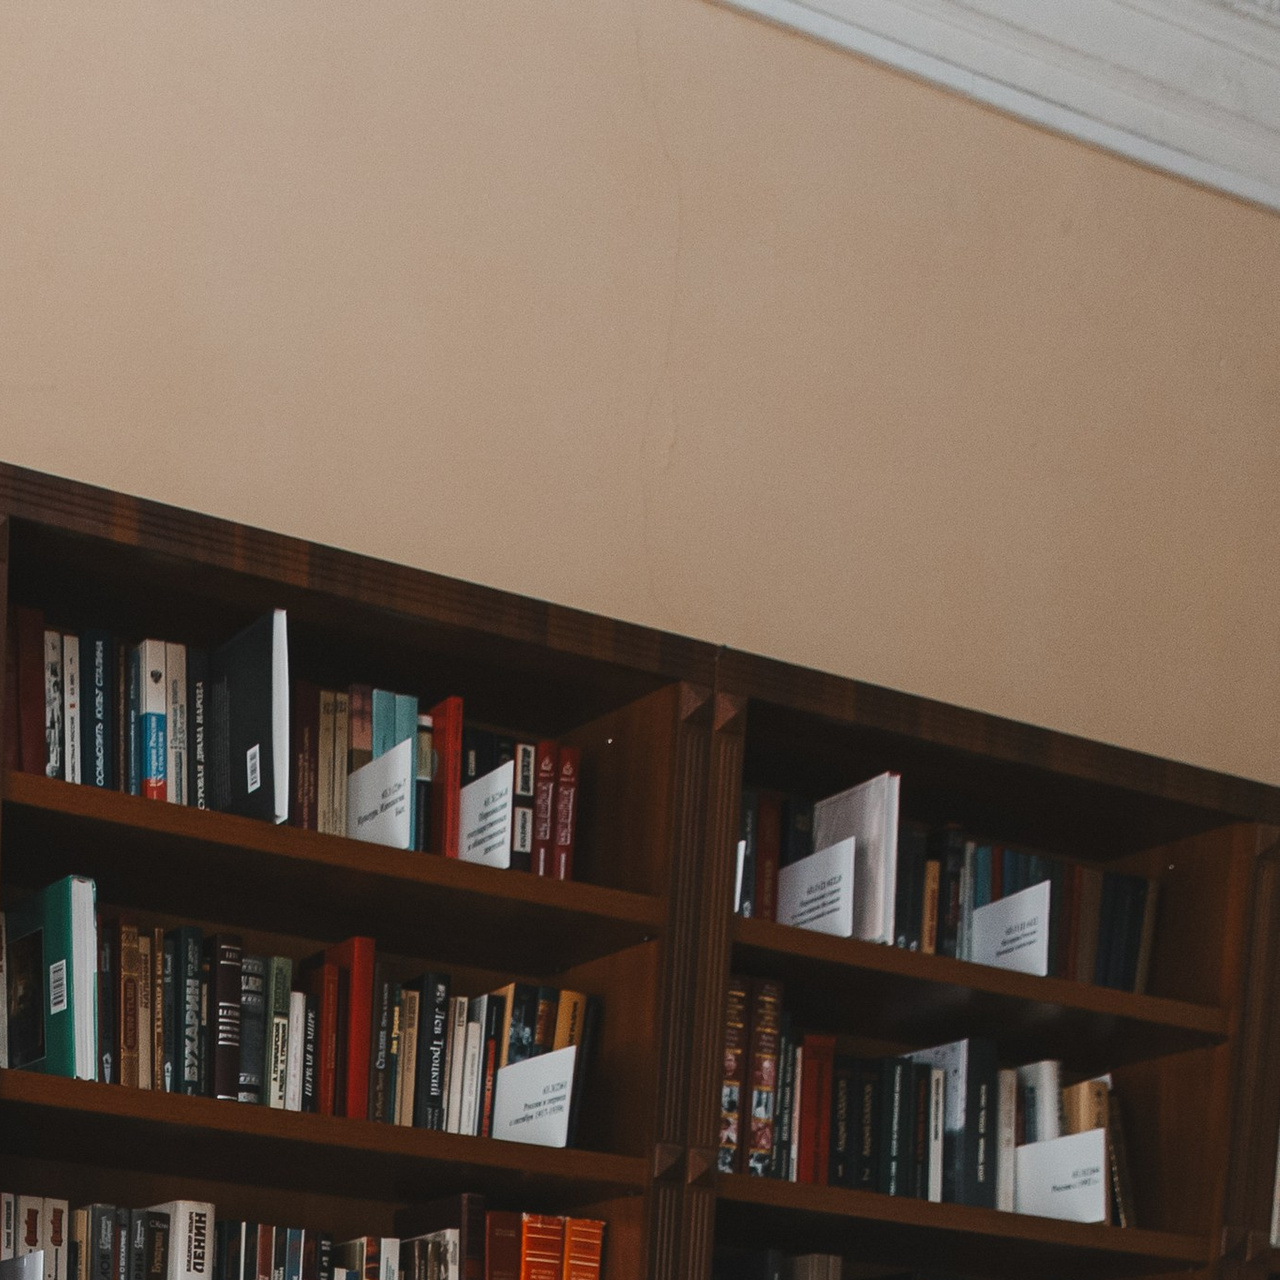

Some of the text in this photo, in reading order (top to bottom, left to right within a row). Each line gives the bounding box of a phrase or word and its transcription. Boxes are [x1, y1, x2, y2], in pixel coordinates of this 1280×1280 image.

[95, 640, 104, 787] ОСМЫСЛИТЬ КУЛЬТ СТАЛИНА
[184, 979, 200, 1082] БУХАРИН
[376, 1029, 386, 1070] Сталин
[430, 1037, 444, 1096] Троцкий
[192, 1212, 206, 1274] ЛЕНИН
